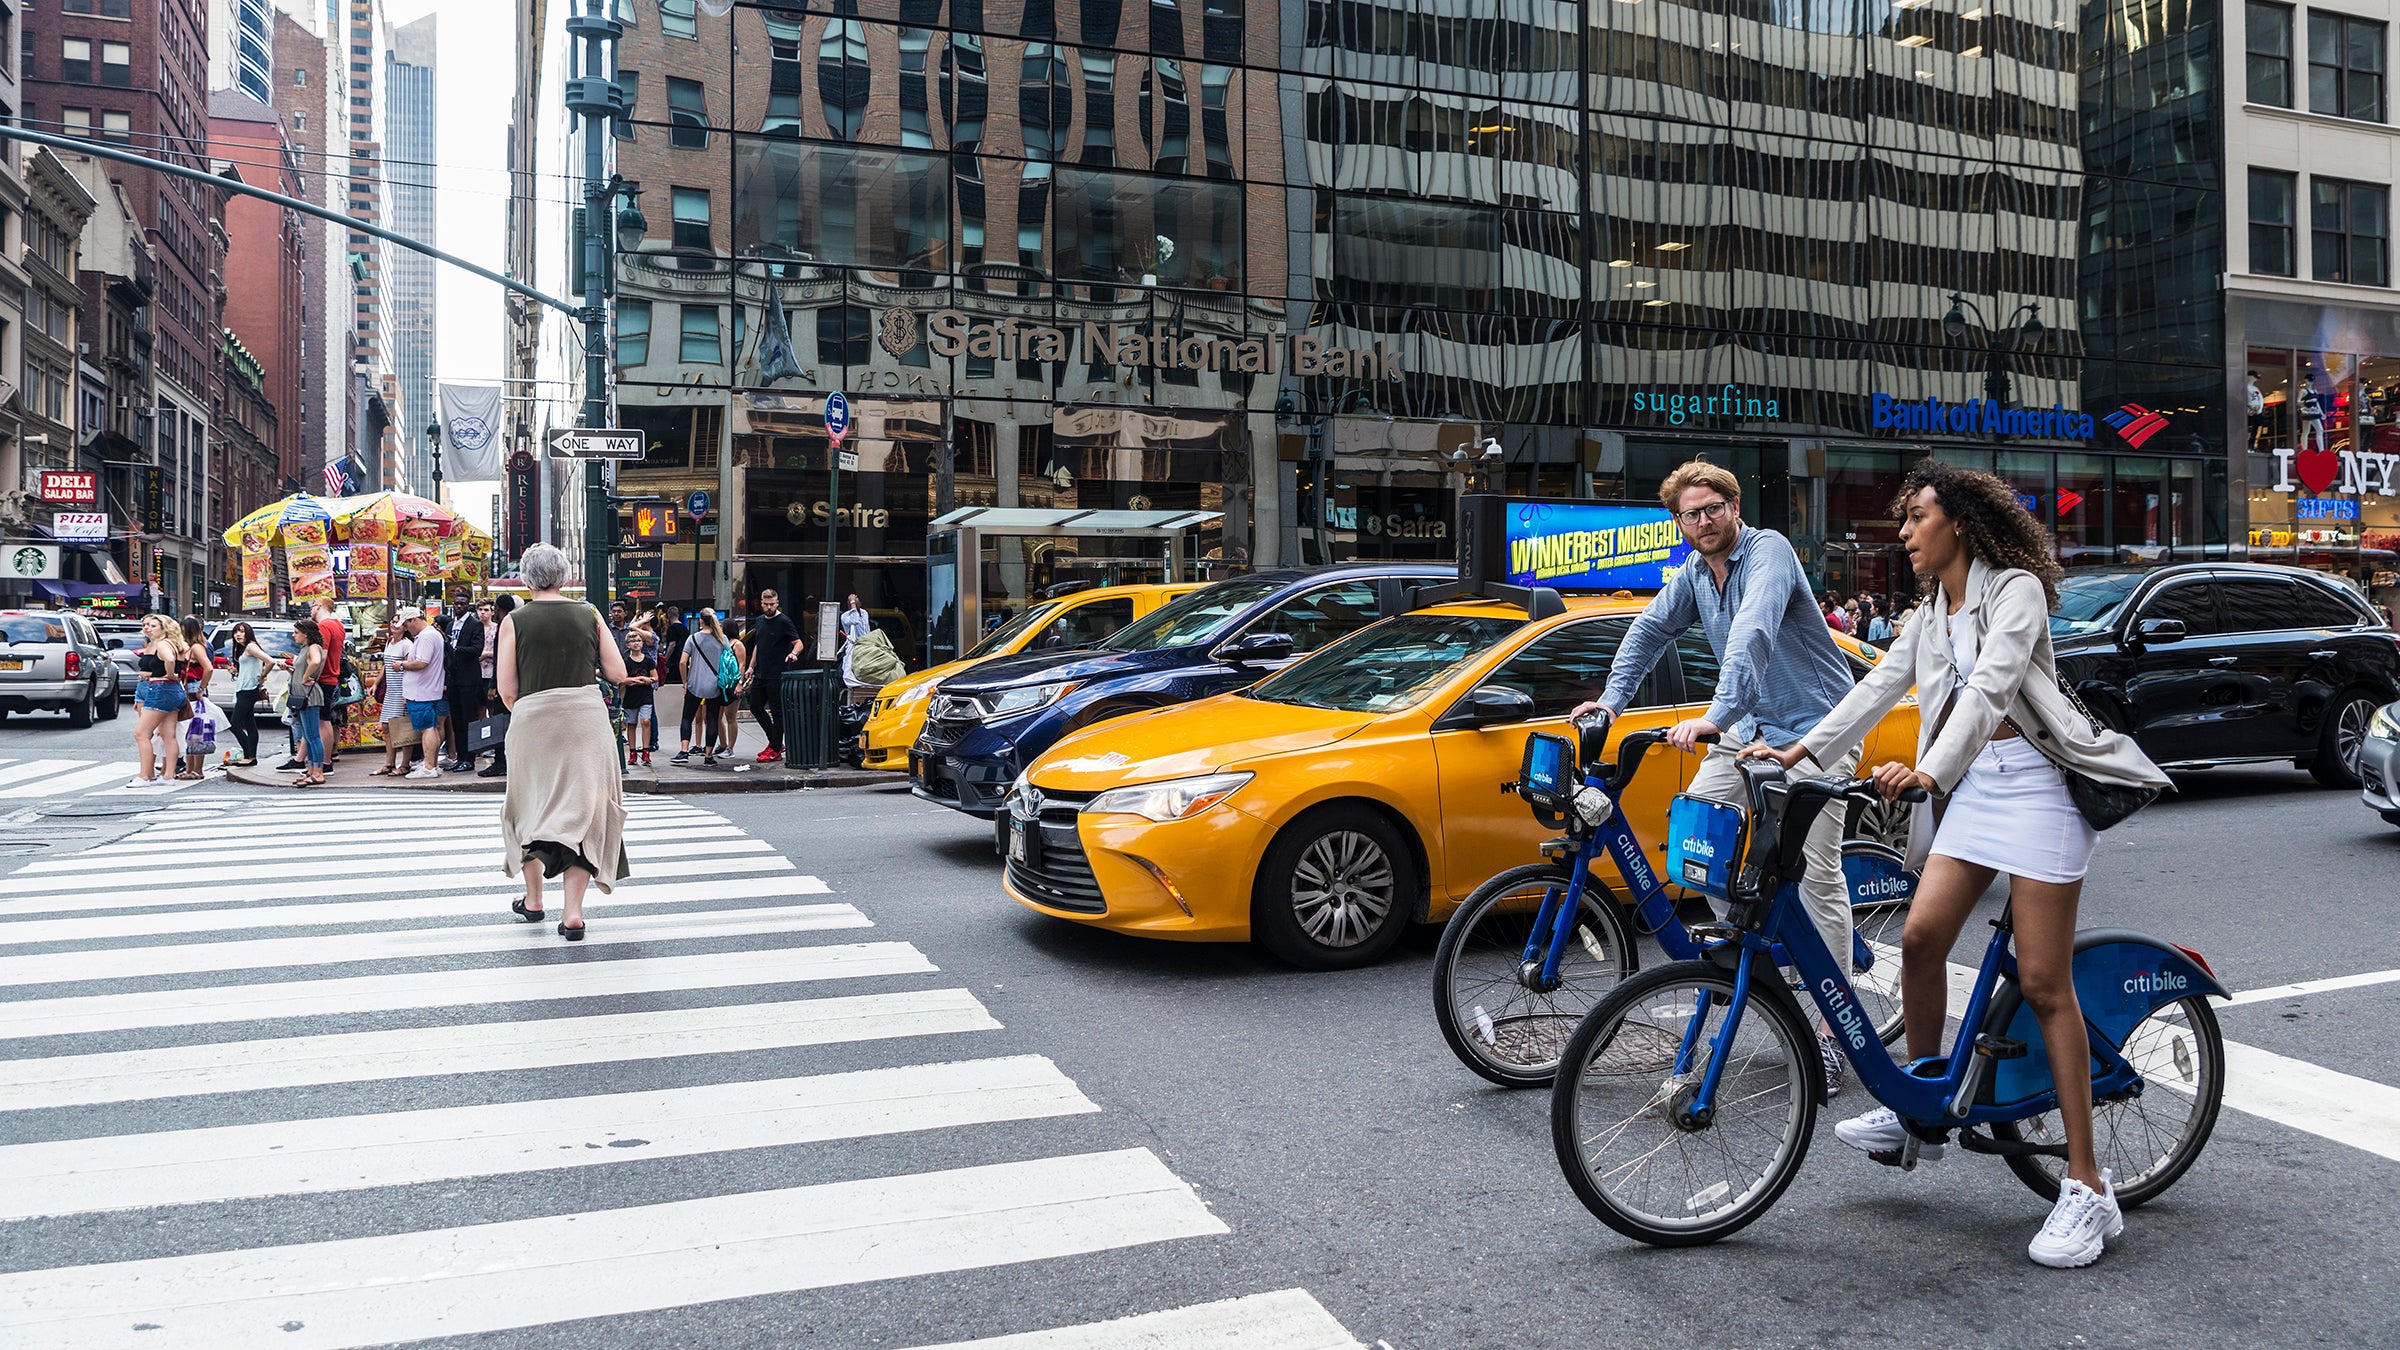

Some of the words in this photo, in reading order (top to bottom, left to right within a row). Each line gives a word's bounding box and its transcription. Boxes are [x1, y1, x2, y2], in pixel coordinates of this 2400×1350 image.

[930, 310, 1066, 362] Safra
[1083, 321, 1276, 374] National
[1292, 334, 1405, 382] Bank
[1633, 384, 1780, 425] sugarfina
[1873, 393, 1947, 431] Bank
[1950, 398, 1979, 433] of
[1982, 399, 2095, 439] America
[562, 438, 590, 450] ONE
[606, 438, 635, 450] WAY
[47, 475, 92, 488] DELI
[2273, 449, 2296, 492] I
[2339, 450, 2398, 496] NY
[44, 489, 73, 499] SALAD
[76, 490, 94, 499] BAR
[812, 501, 889, 528] Safra
[2297, 497, 2354, 519] GIFTS
[60, 515, 103, 524] PIZZA
[664, 509, 677, 535] 6
[1386, 514, 1447, 538] Safra
[620, 551, 662, 559] MEDITERRANEAN
[1464, 511, 1472, 577] 7Y26
[1511, 531, 1585, 575] WINNER
[1583, 528, 1617, 560] BEST
[1616, 519, 1682, 555] MUSICAL!
[629, 569, 651, 577] TURKISH
[92, 598, 121, 607] Dinner
[1501, 781, 1520, 794] NY
[1542, 774, 1552, 784] bike
[1683, 838, 1696, 852] citi
[1696, 841, 1714, 858] bike
[1618, 834, 1636, 859] citi
[1630, 857, 1651, 891] bike
[1858, 879, 1880, 896] citi
[1881, 878, 1908, 894] bike
[2123, 974, 2150, 994] citi
[2152, 971, 2187, 990] bike
[1820, 978, 1843, 1011] citi
[1836, 1004, 1867, 1050] bike
